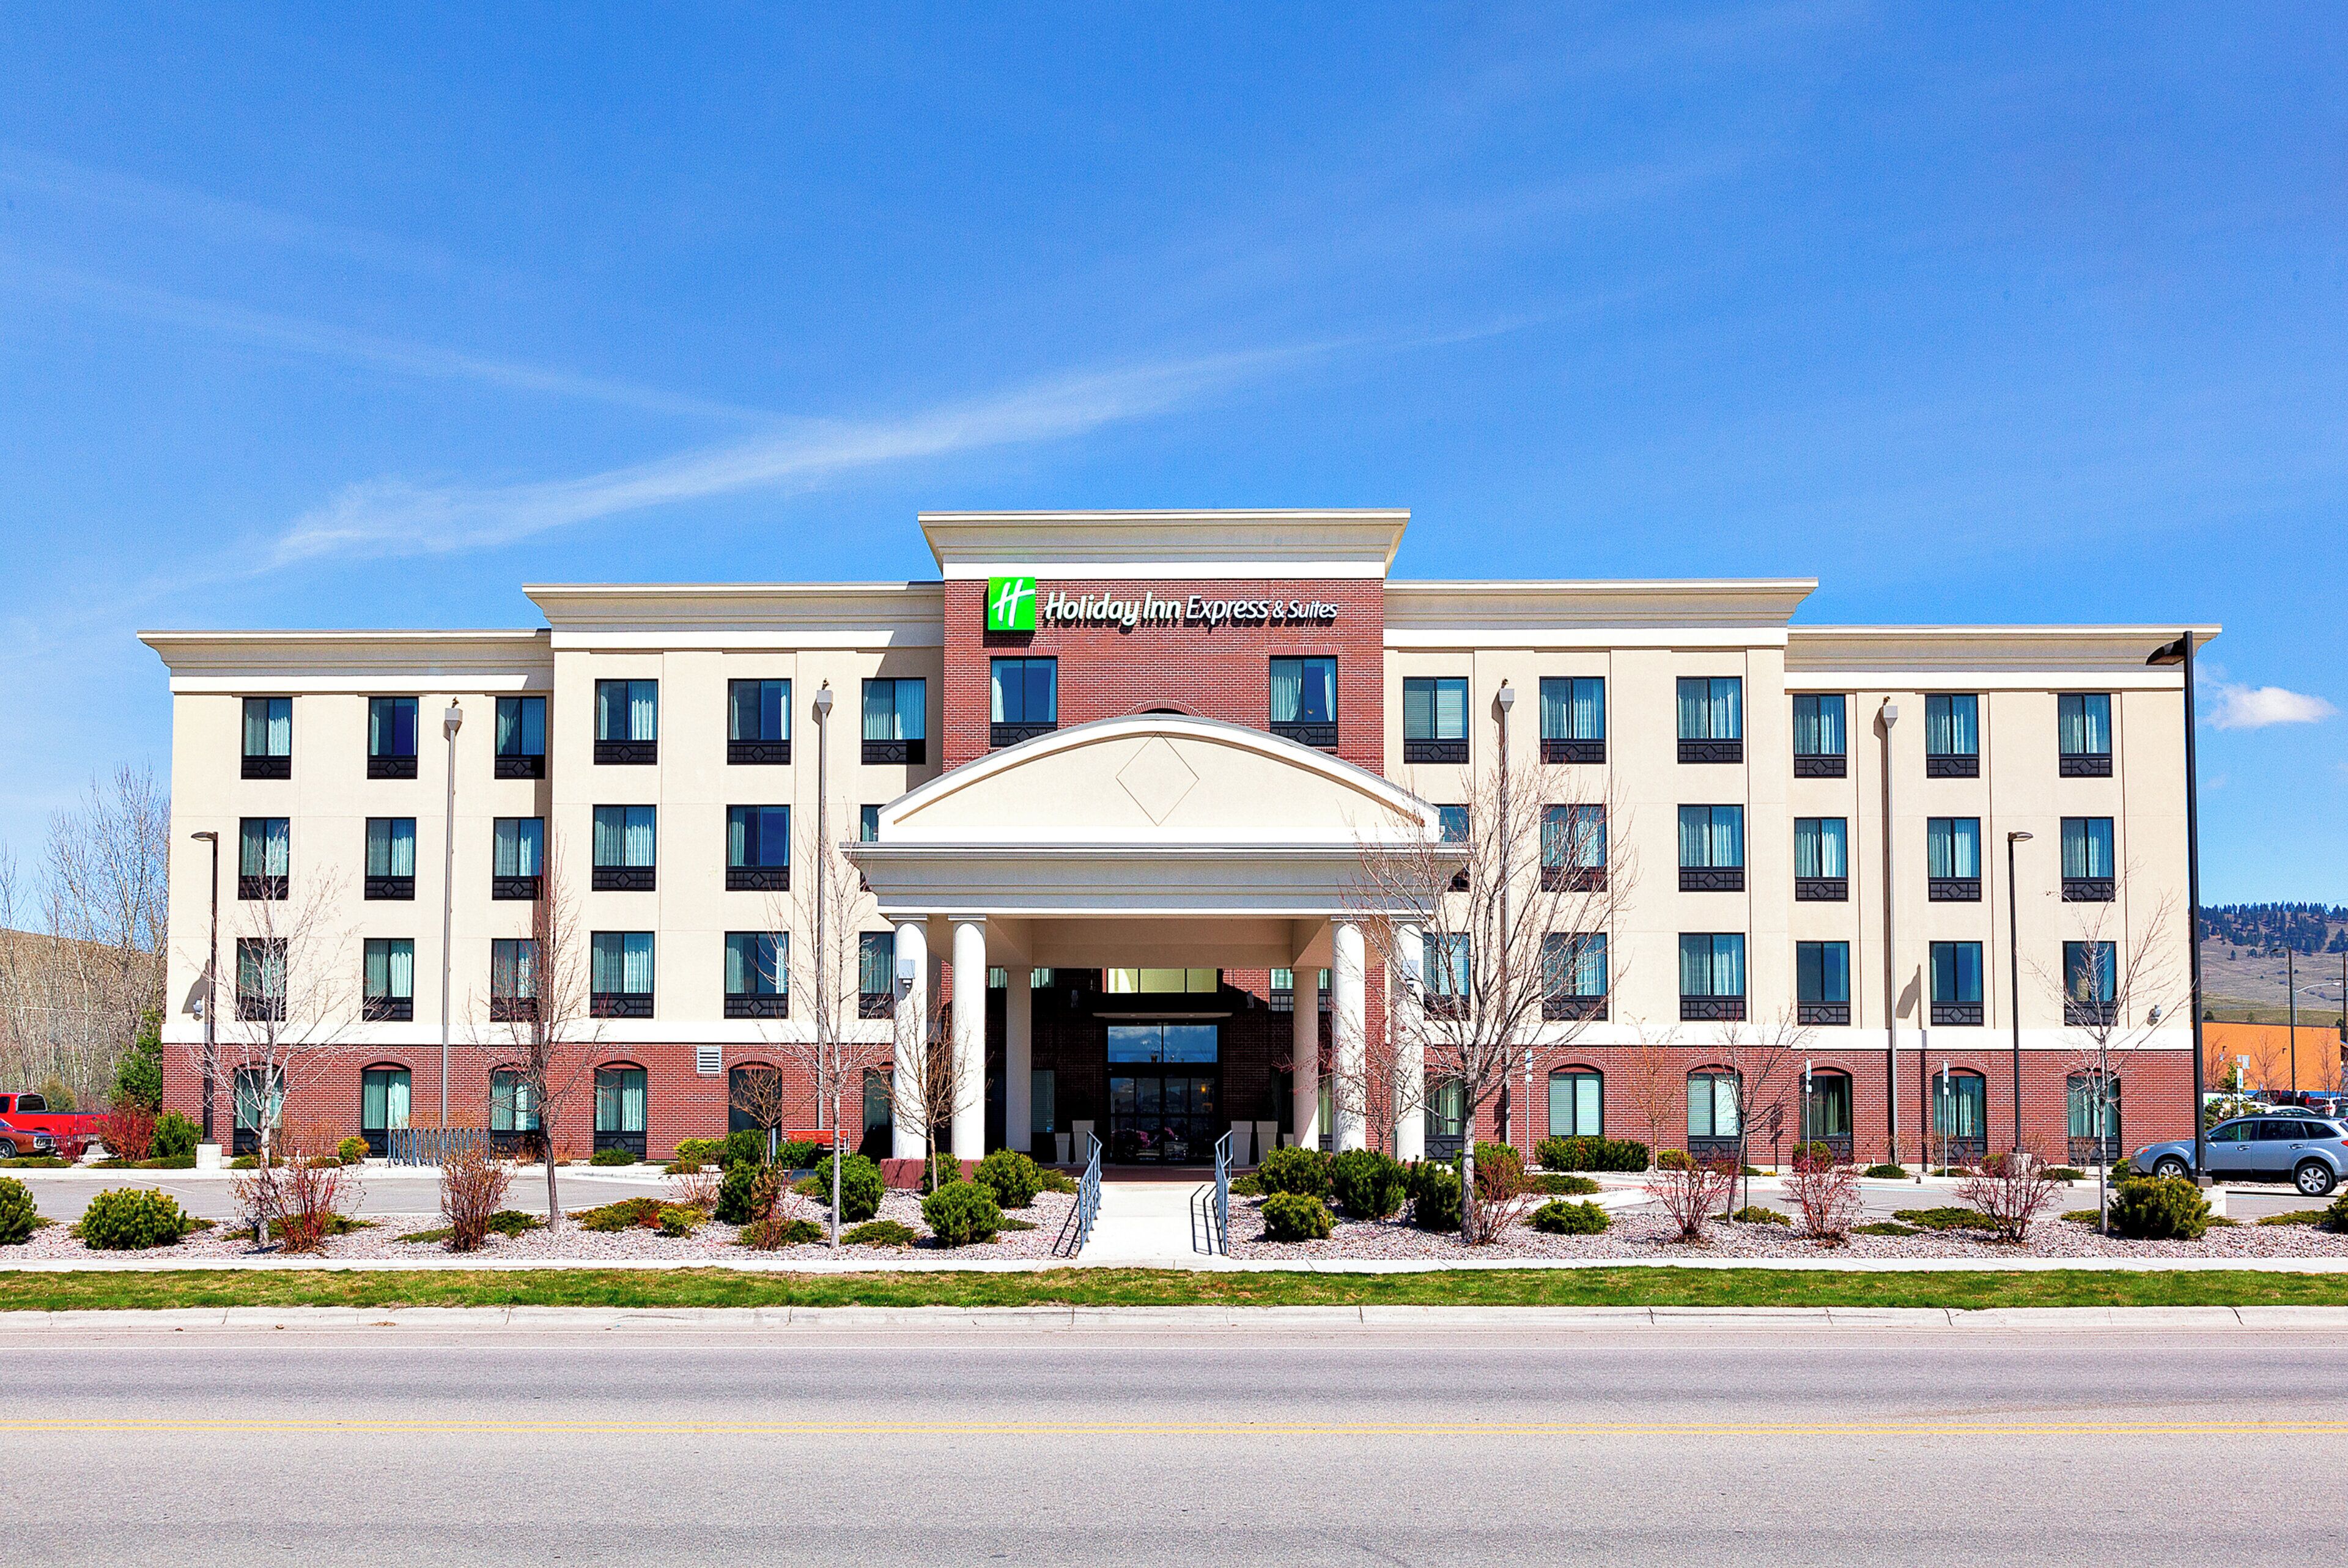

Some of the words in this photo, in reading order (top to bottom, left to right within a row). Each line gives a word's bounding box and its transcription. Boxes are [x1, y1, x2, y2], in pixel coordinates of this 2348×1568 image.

[1044, 591, 1140, 626] Holiday
[1143, 591, 1181, 619] Inn
[1186, 595, 1269, 625] Express
[1272, 600, 1285, 618] &
[1288, 600, 1338, 618] Suites
